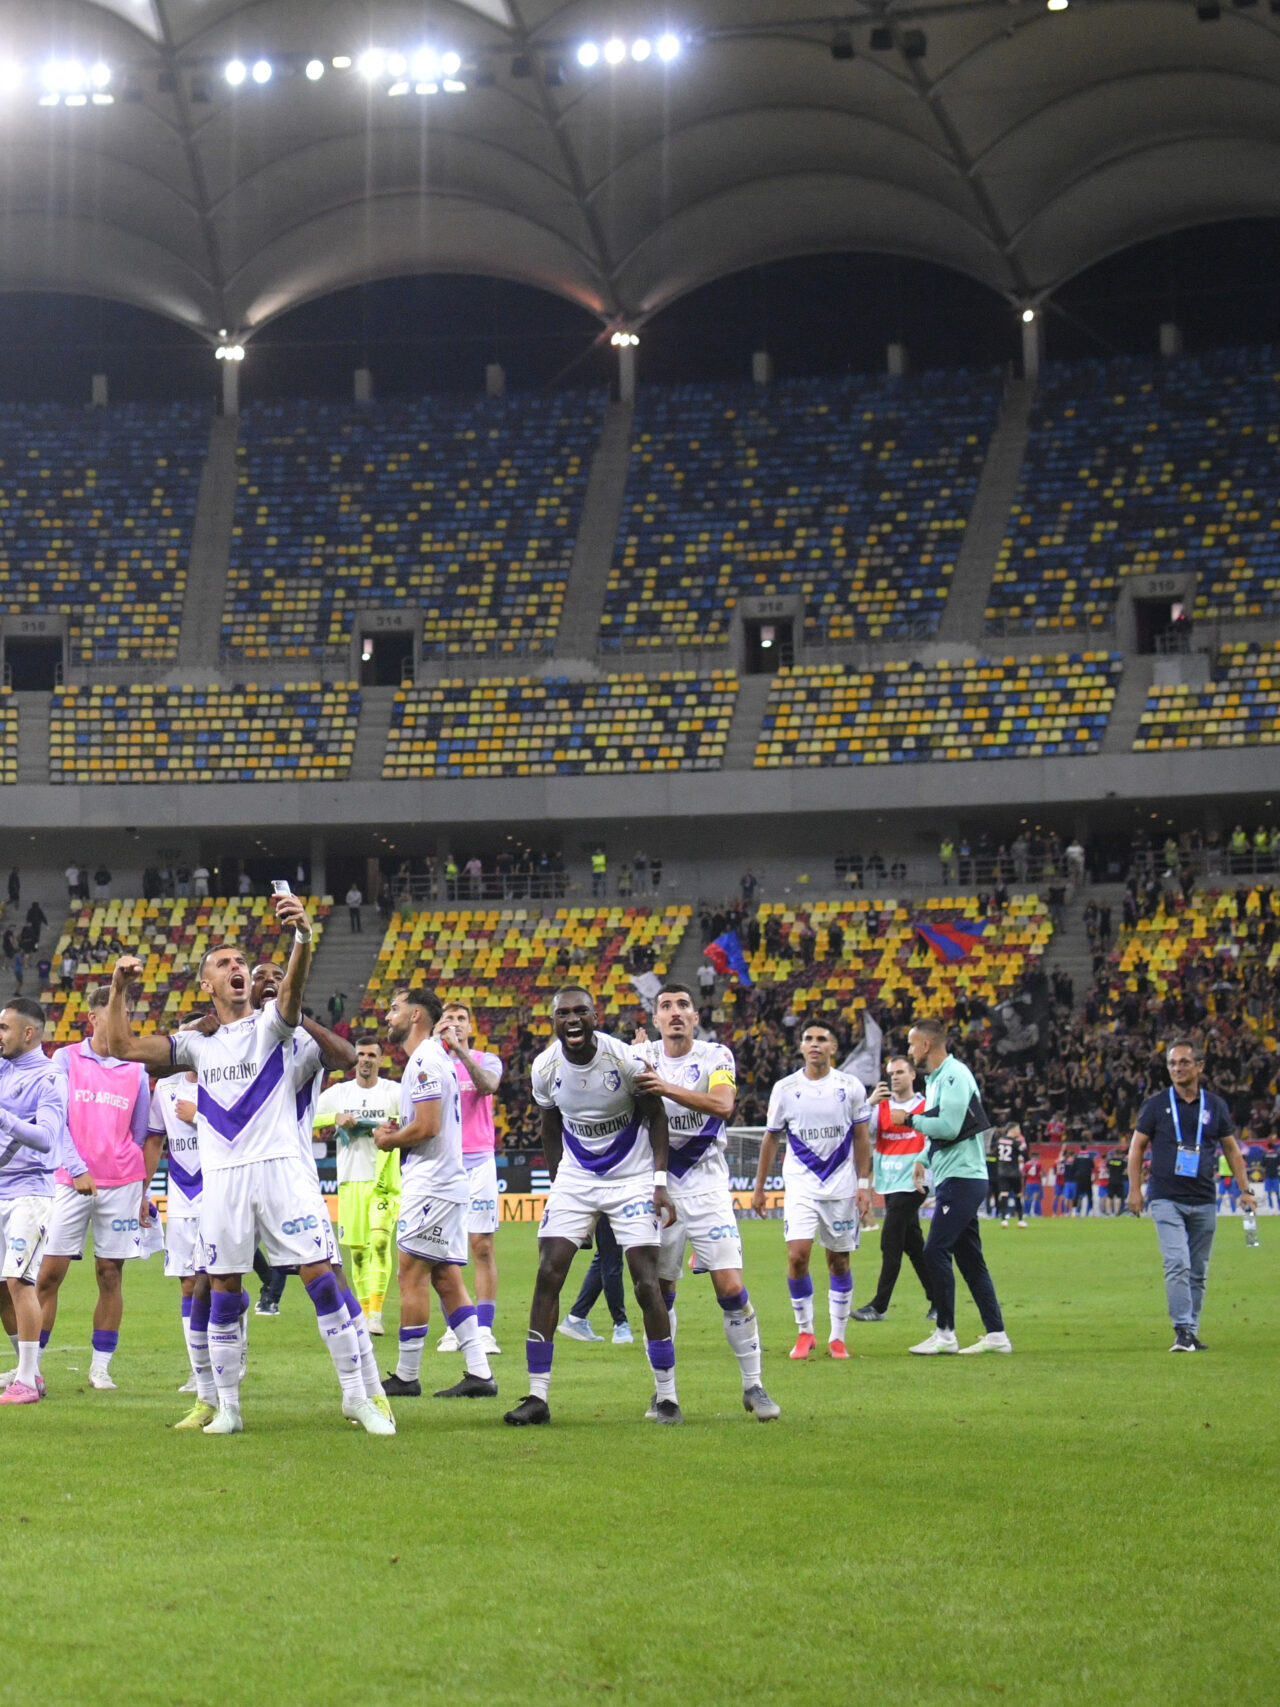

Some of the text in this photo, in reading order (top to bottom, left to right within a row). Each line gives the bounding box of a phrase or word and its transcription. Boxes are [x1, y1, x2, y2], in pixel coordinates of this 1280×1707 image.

[376, 615, 402, 626] 314
[203, 1062, 258, 1086] VAD CAZINO
[75, 1089, 129, 1111] FC ARGES
[568, 1112, 630, 1137] VLAD CAZINO
[670, 1110, 704, 1131] CAZINO
[800, 1128, 819, 1140] VLAD
[998, 1144, 1013, 1162] 32
[472, 1199, 495, 1211] one
[623, 1199, 658, 1219] one
[111, 1218, 139, 1232] one
[282, 1214, 319, 1236] one
[832, 1219, 855, 1232] one
[8, 1237, 27, 1251] ne
[326, 1328, 338, 1336] FC
